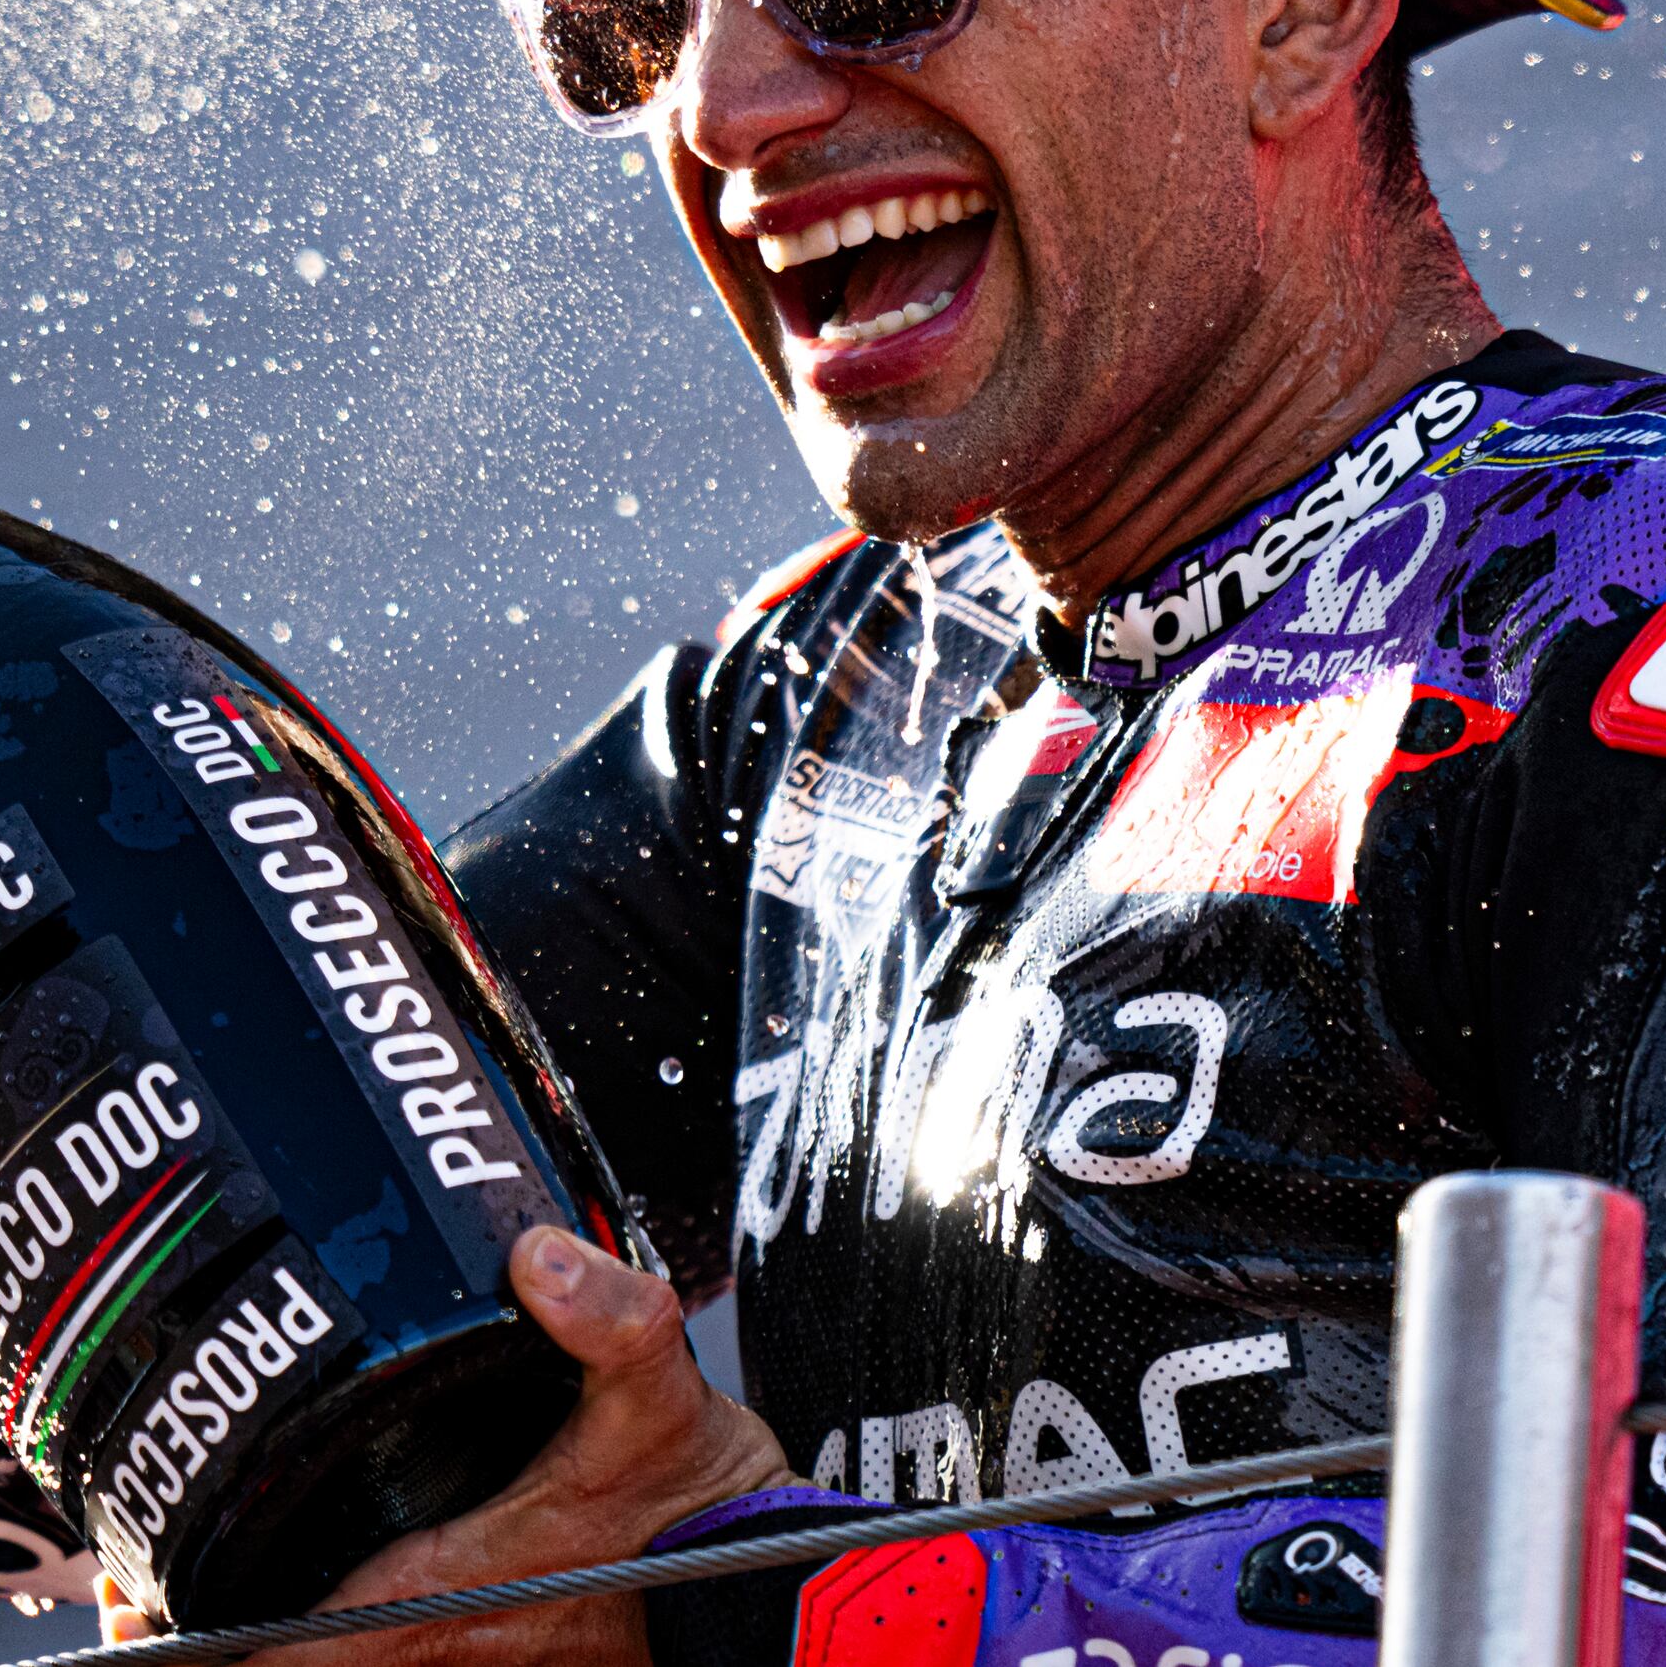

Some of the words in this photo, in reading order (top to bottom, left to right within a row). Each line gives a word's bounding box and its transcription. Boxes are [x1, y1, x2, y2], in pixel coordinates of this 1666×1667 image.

[1094, 380, 1477, 679] alpinestars
[1503, 427, 1666, 452] MICHELIN
[153, 698, 255, 784] DOC
[230, 795, 521, 1189] PROSECCO
[54, 1061, 201, 1207] DOC
[101, 1267, 334, 1566] PROSECCO
